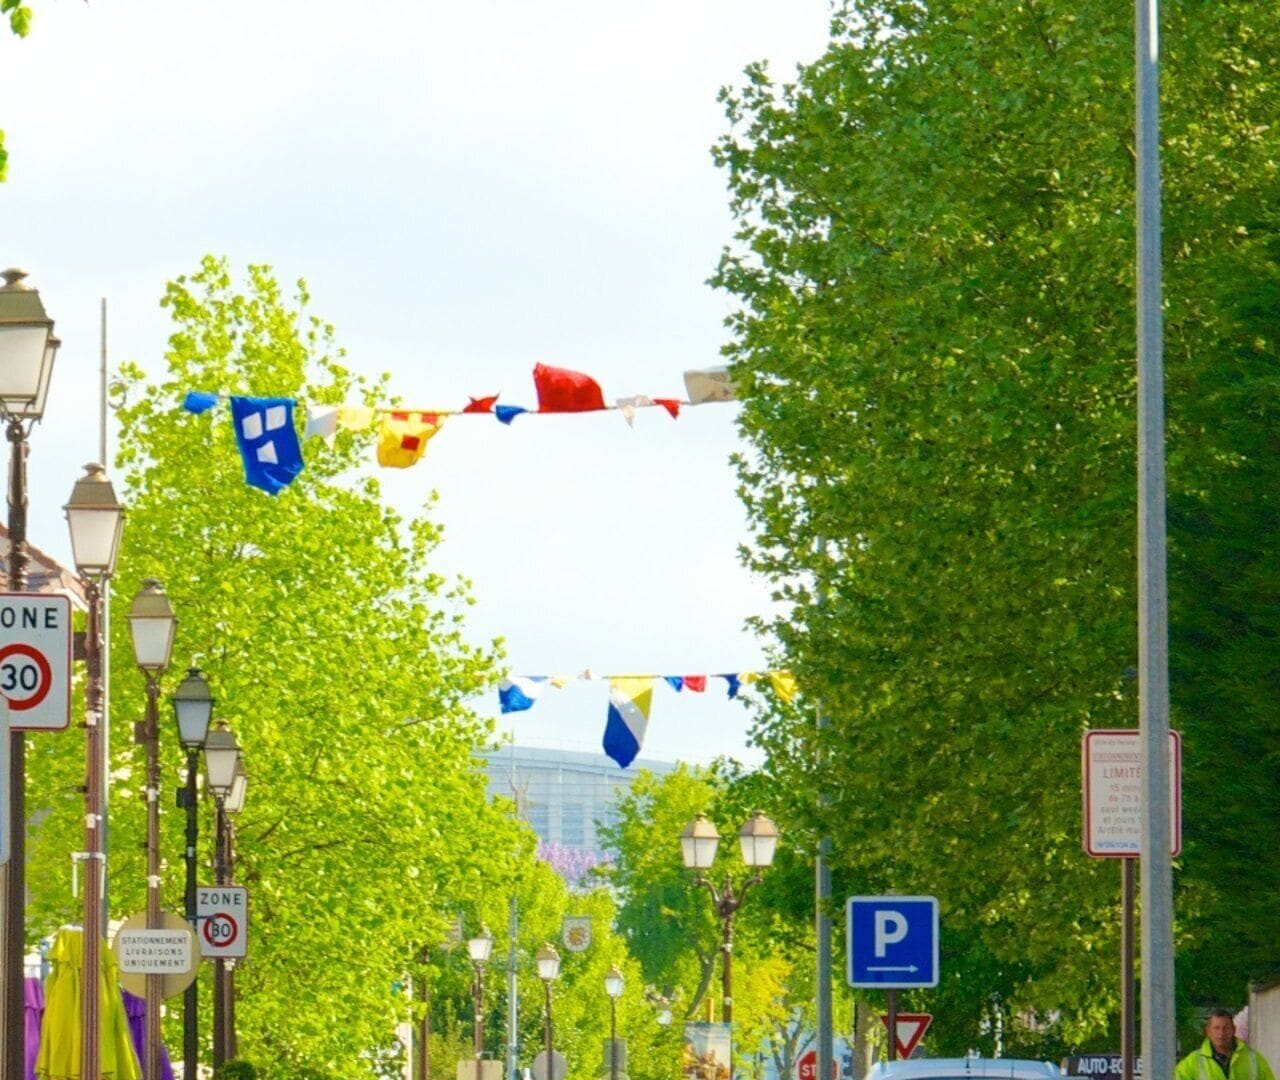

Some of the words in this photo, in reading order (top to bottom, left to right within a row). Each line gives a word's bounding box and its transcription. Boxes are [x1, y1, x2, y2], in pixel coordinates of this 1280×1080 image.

[0, 663, 39, 692] 30
[200, 893, 241, 905] ZONE
[875, 910, 908, 957] P
[122, 936, 187, 945] STATIONNEMENT
[124, 959, 185, 967] UNIQUEMENT
